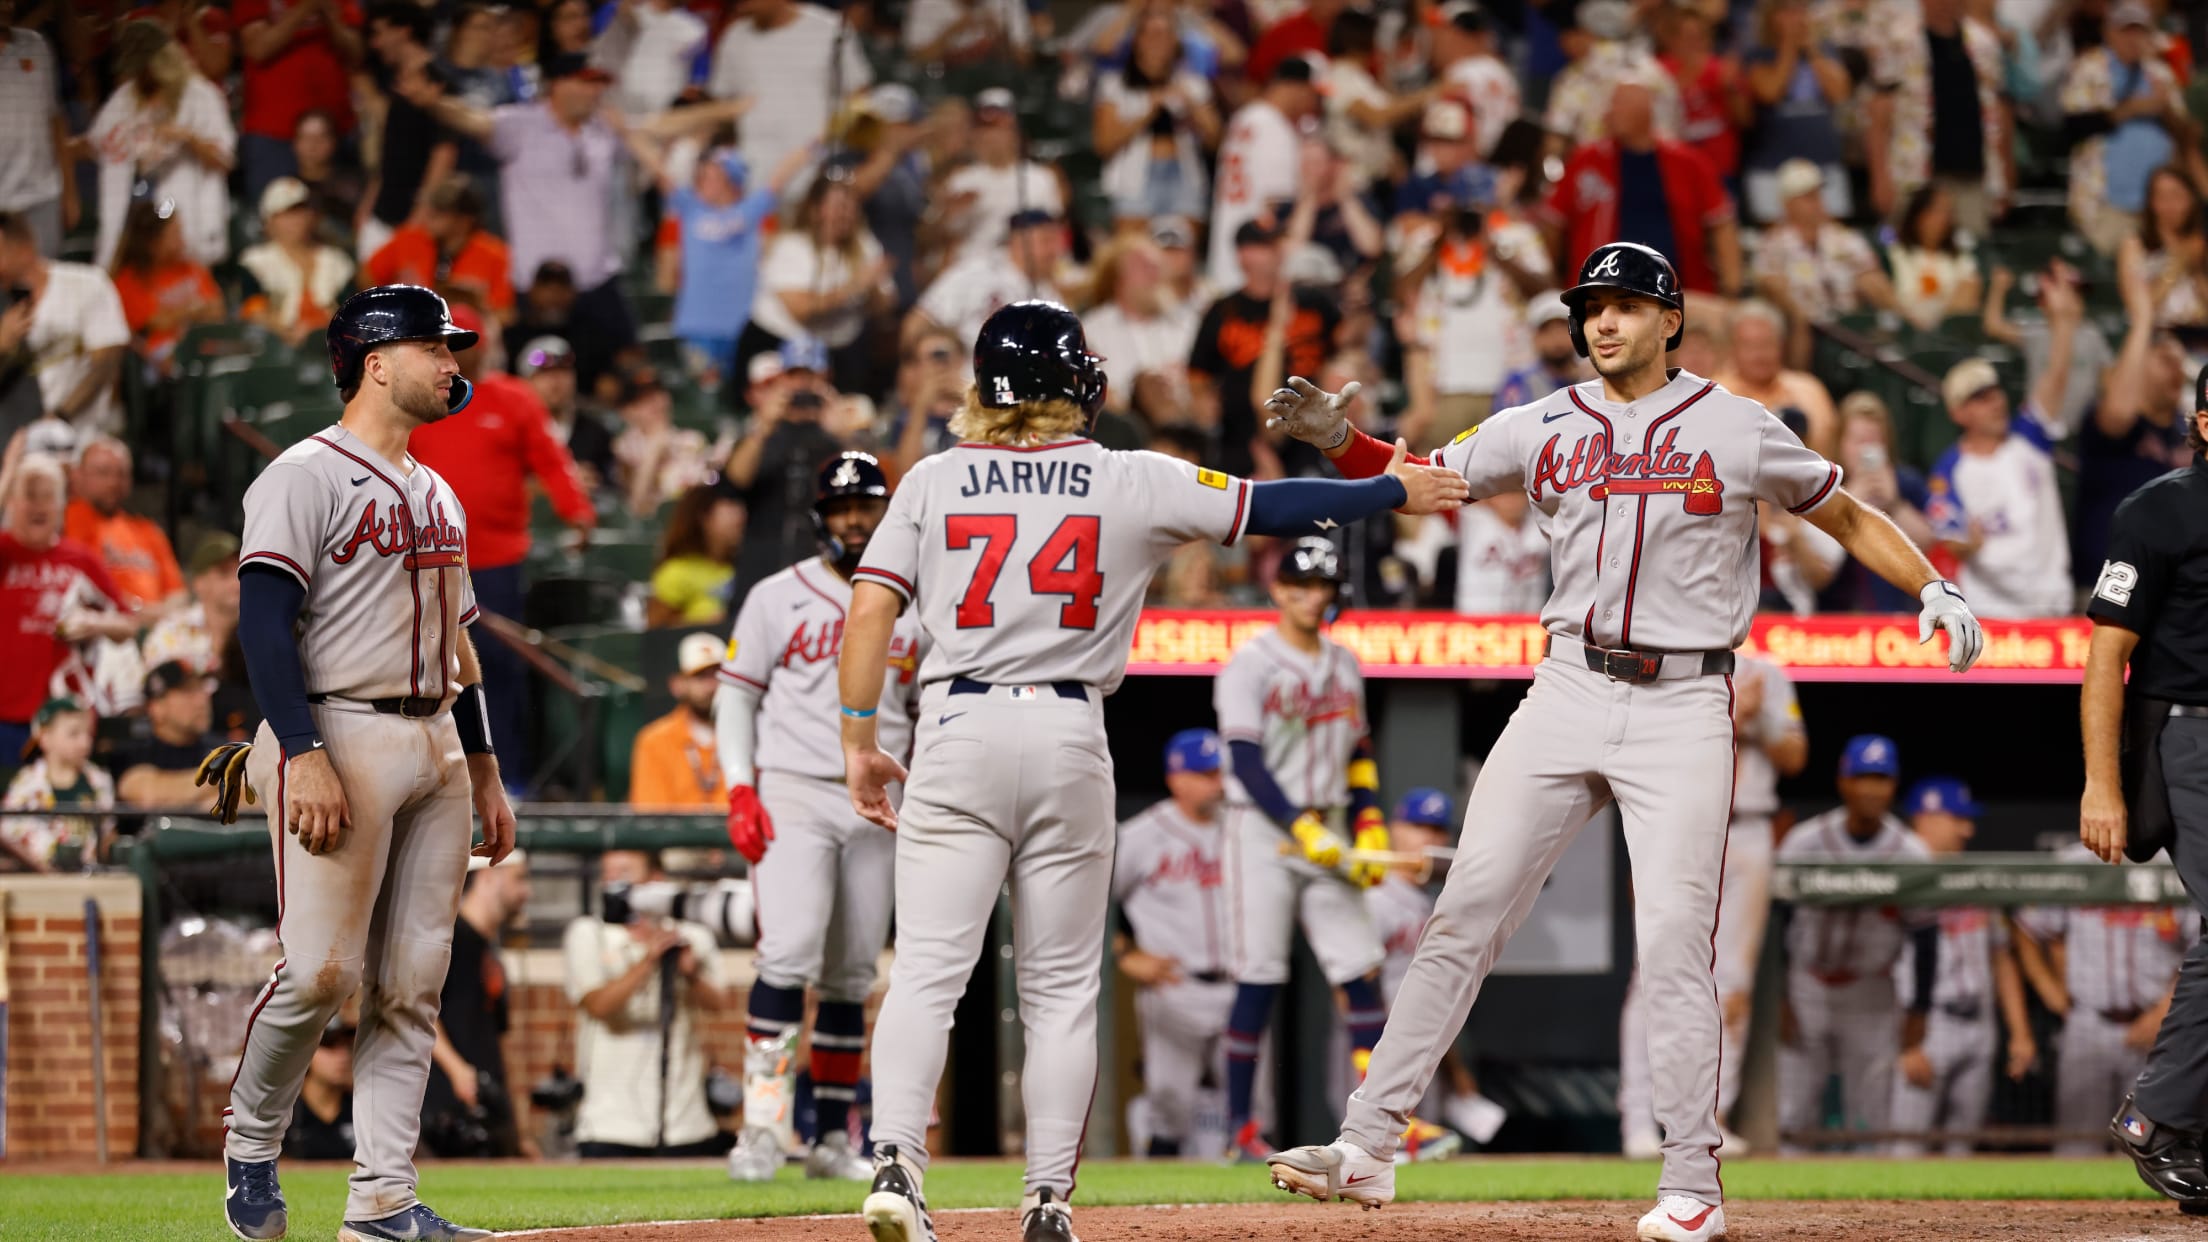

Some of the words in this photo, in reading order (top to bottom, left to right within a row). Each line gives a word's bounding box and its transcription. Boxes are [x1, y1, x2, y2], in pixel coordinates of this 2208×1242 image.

[993, 375, 1010, 391] 74
[961, 459, 1092, 498] JARVIS
[1530, 426, 1692, 502] Atlanta
[331, 498, 465, 565] Atlanta
[945, 512, 1104, 631] 74
[2091, 559, 2138, 607] 2
[1641, 658, 1657, 674] 28
[1980, 628, 2054, 667] ake
